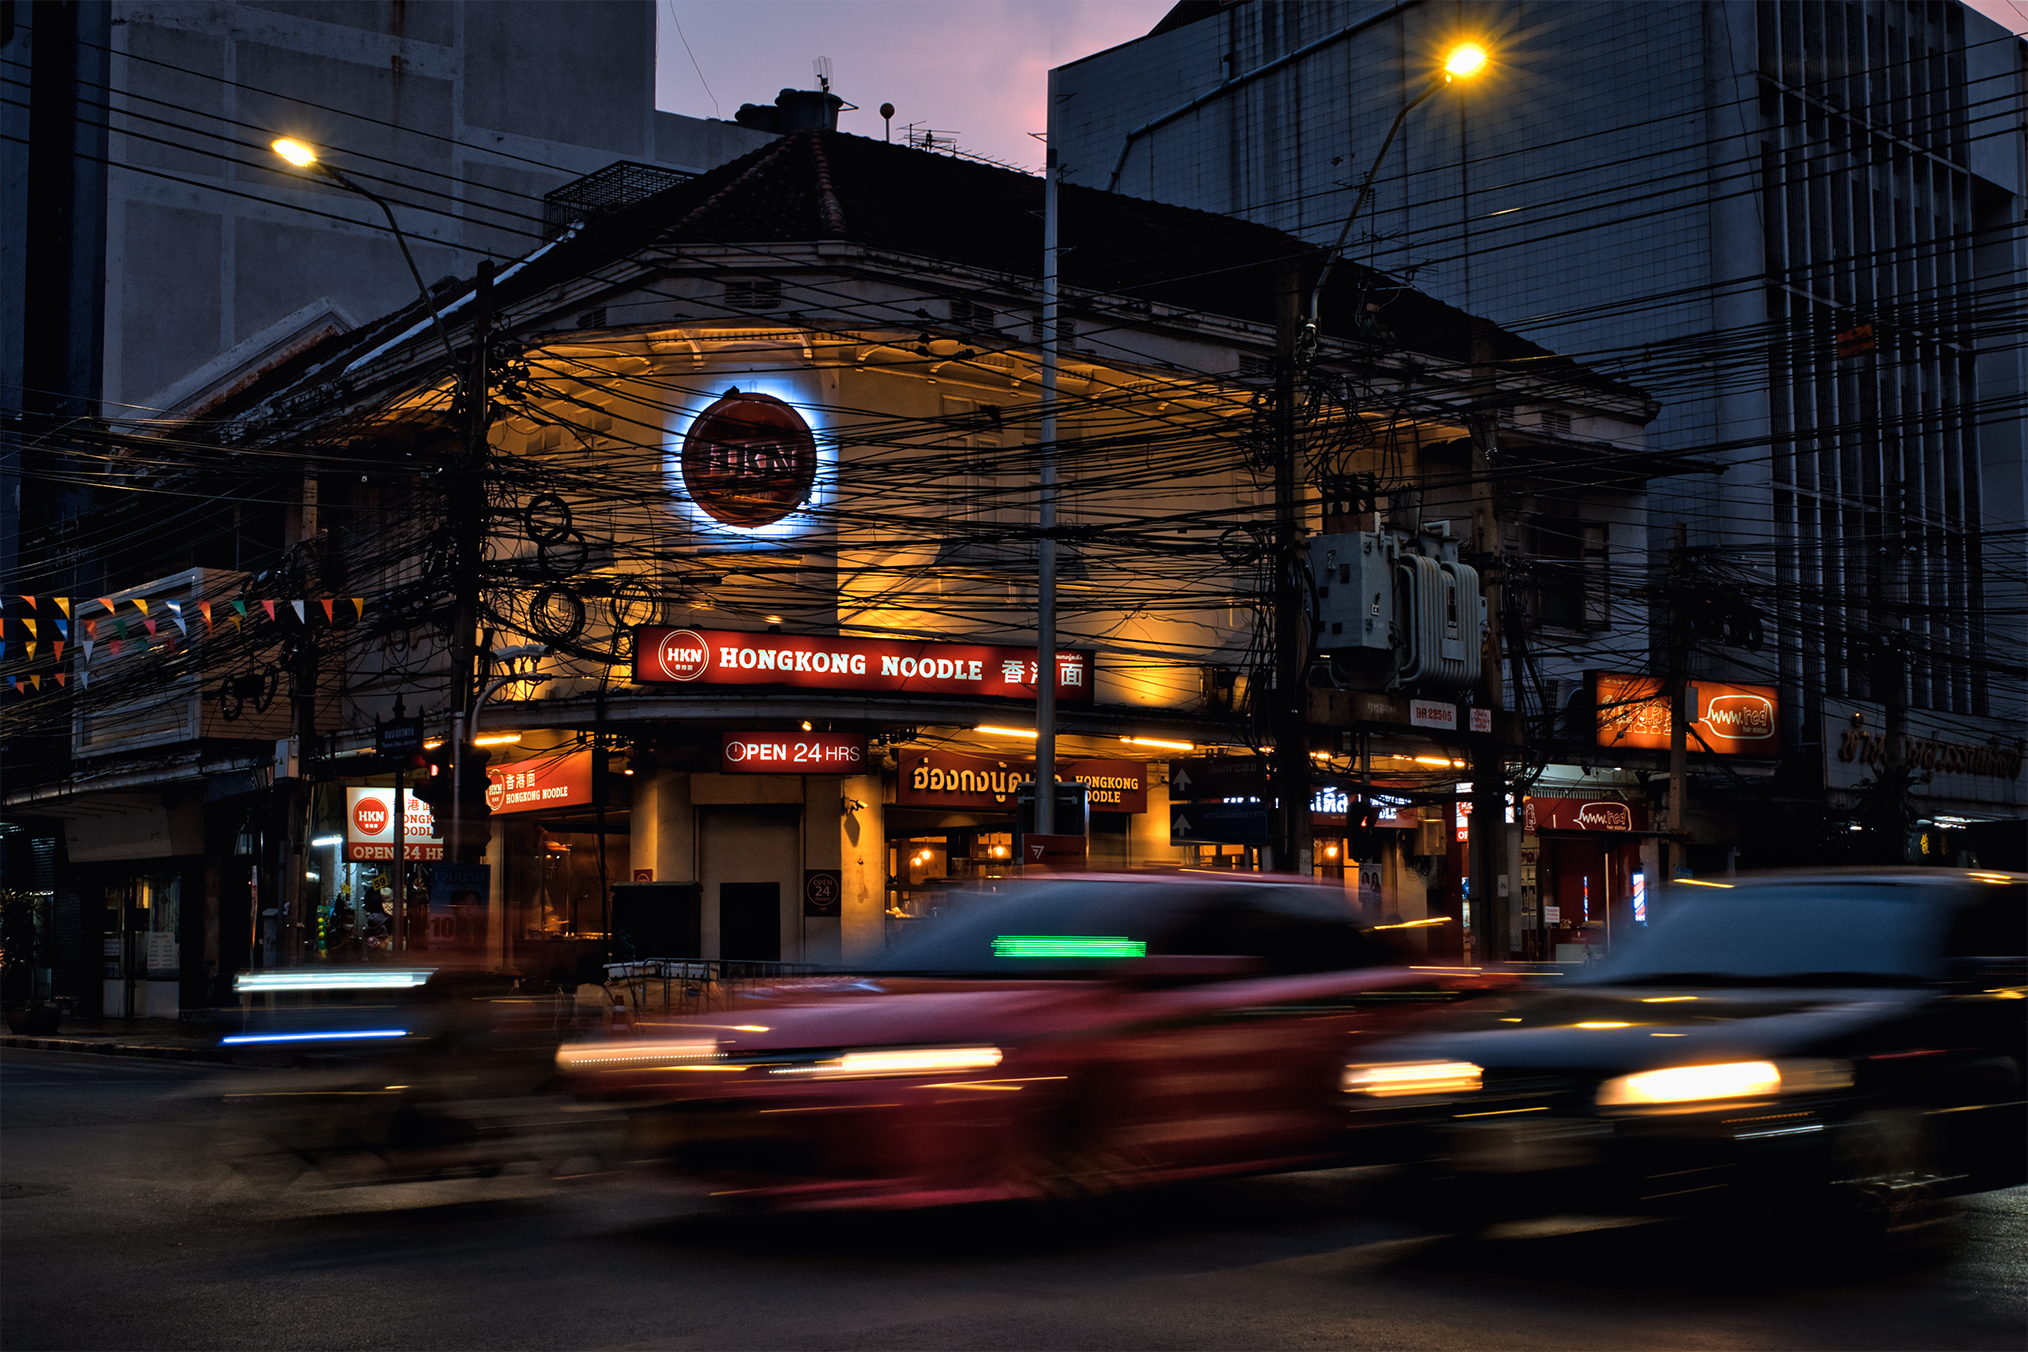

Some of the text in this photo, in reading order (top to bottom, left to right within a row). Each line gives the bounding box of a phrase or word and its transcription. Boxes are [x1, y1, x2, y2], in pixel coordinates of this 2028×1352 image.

[667, 647, 703, 663] HKN
[719, 647, 983, 681] HONGKONG NOODLE
[1416, 707, 1452, 722] BR 22505
[725, 741, 861, 762] OPEN 24 HRS
[488, 783, 503, 796] HKN
[1075, 775, 1139, 790] HONGKONG
[506, 786, 568, 804] HONGKONG NOODLE
[1087, 790, 1121, 803] OODLE
[359, 811, 384, 821] HKN
[353, 846, 395, 859] OPEN
[403, 846, 421, 859] 24
[373, 877, 386, 888] 59
[815, 886, 831, 897] 24
